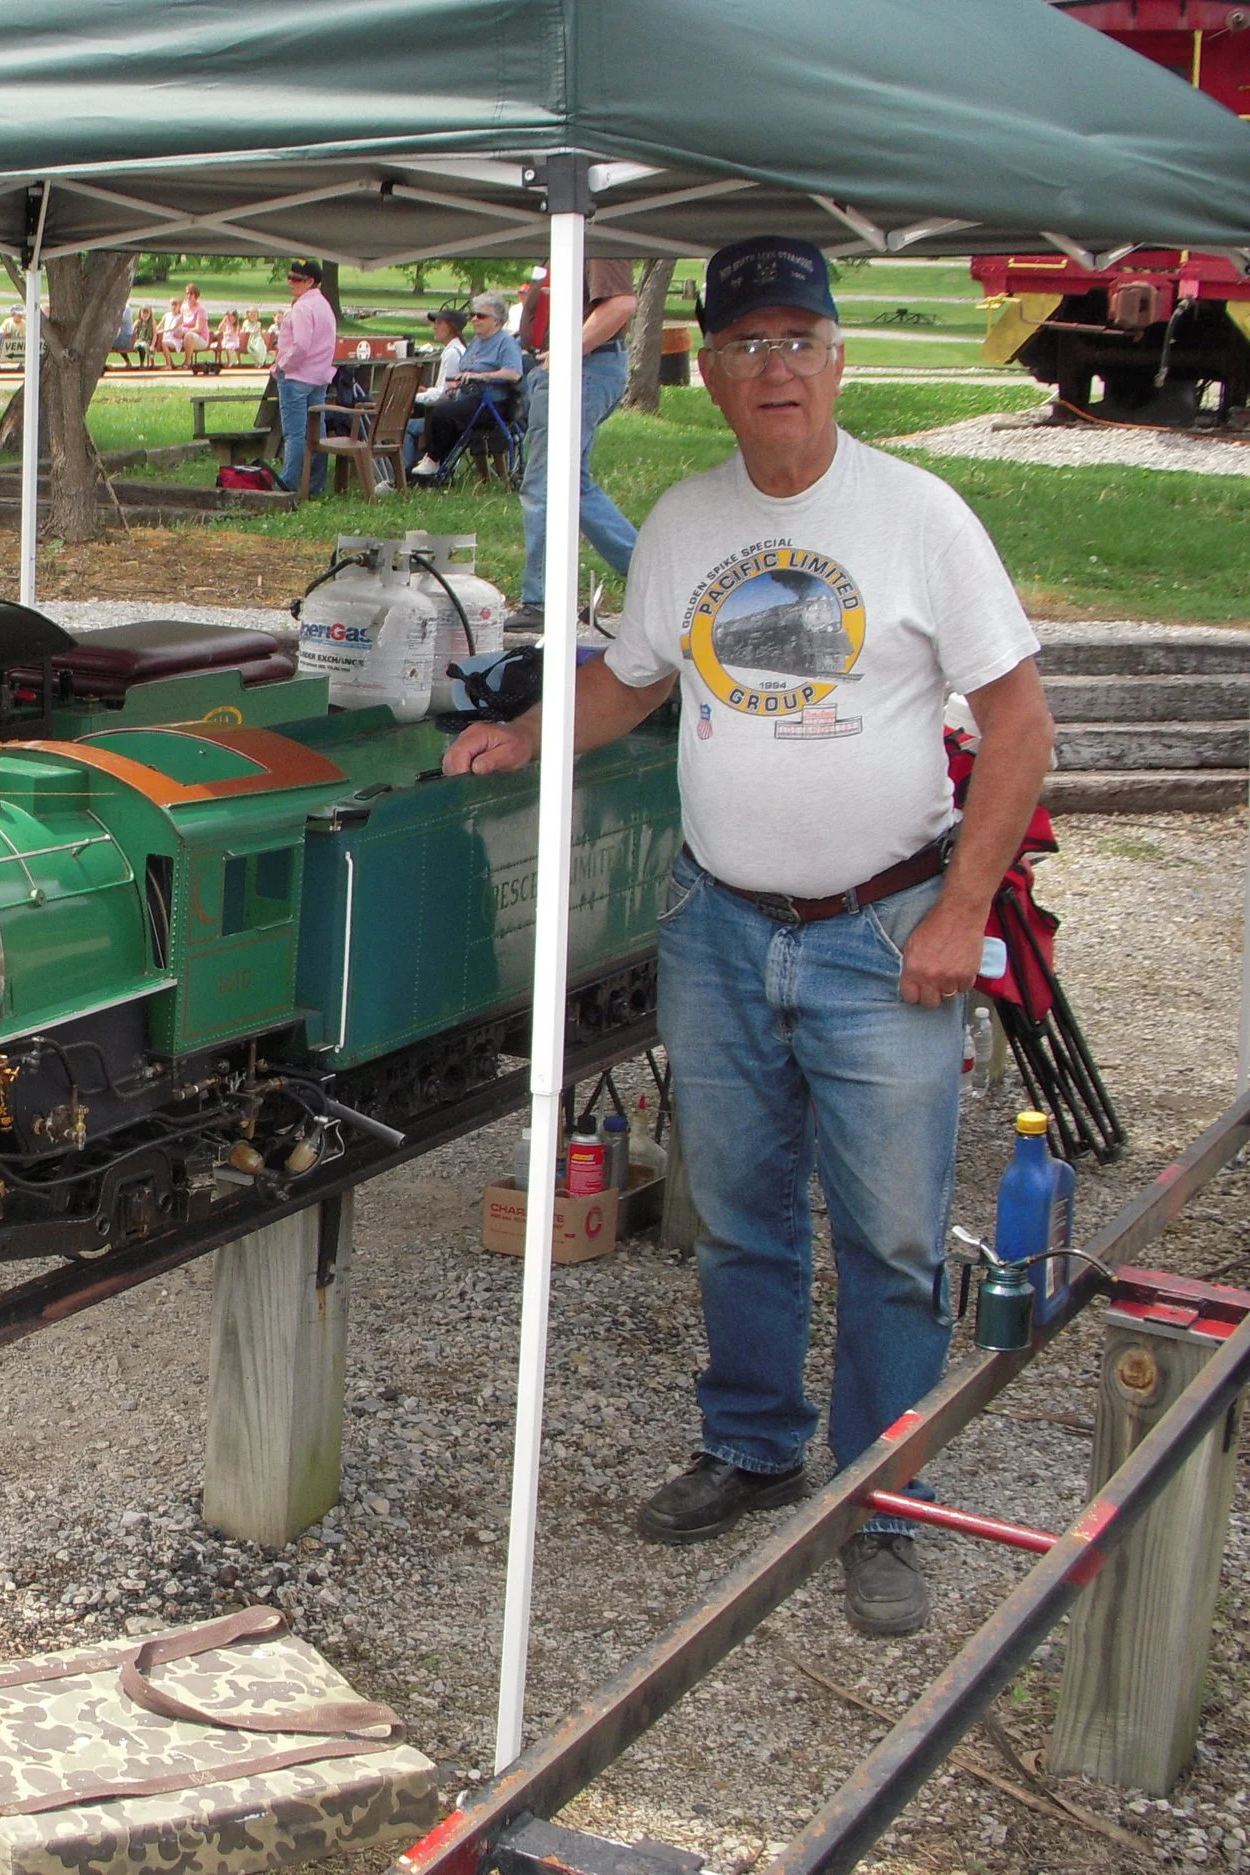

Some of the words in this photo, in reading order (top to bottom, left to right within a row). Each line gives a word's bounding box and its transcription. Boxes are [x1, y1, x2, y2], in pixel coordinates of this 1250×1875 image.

[681, 581, 708, 629] GOLDEN
[707, 553, 739, 580] SPIKE
[741, 538, 794, 557] SPECIAL
[699, 552, 777, 616] PACIFIC
[789, 551, 859, 610] LIMITED
[729, 685, 816, 711] GROUP
[759, 681, 787, 690] 1994
